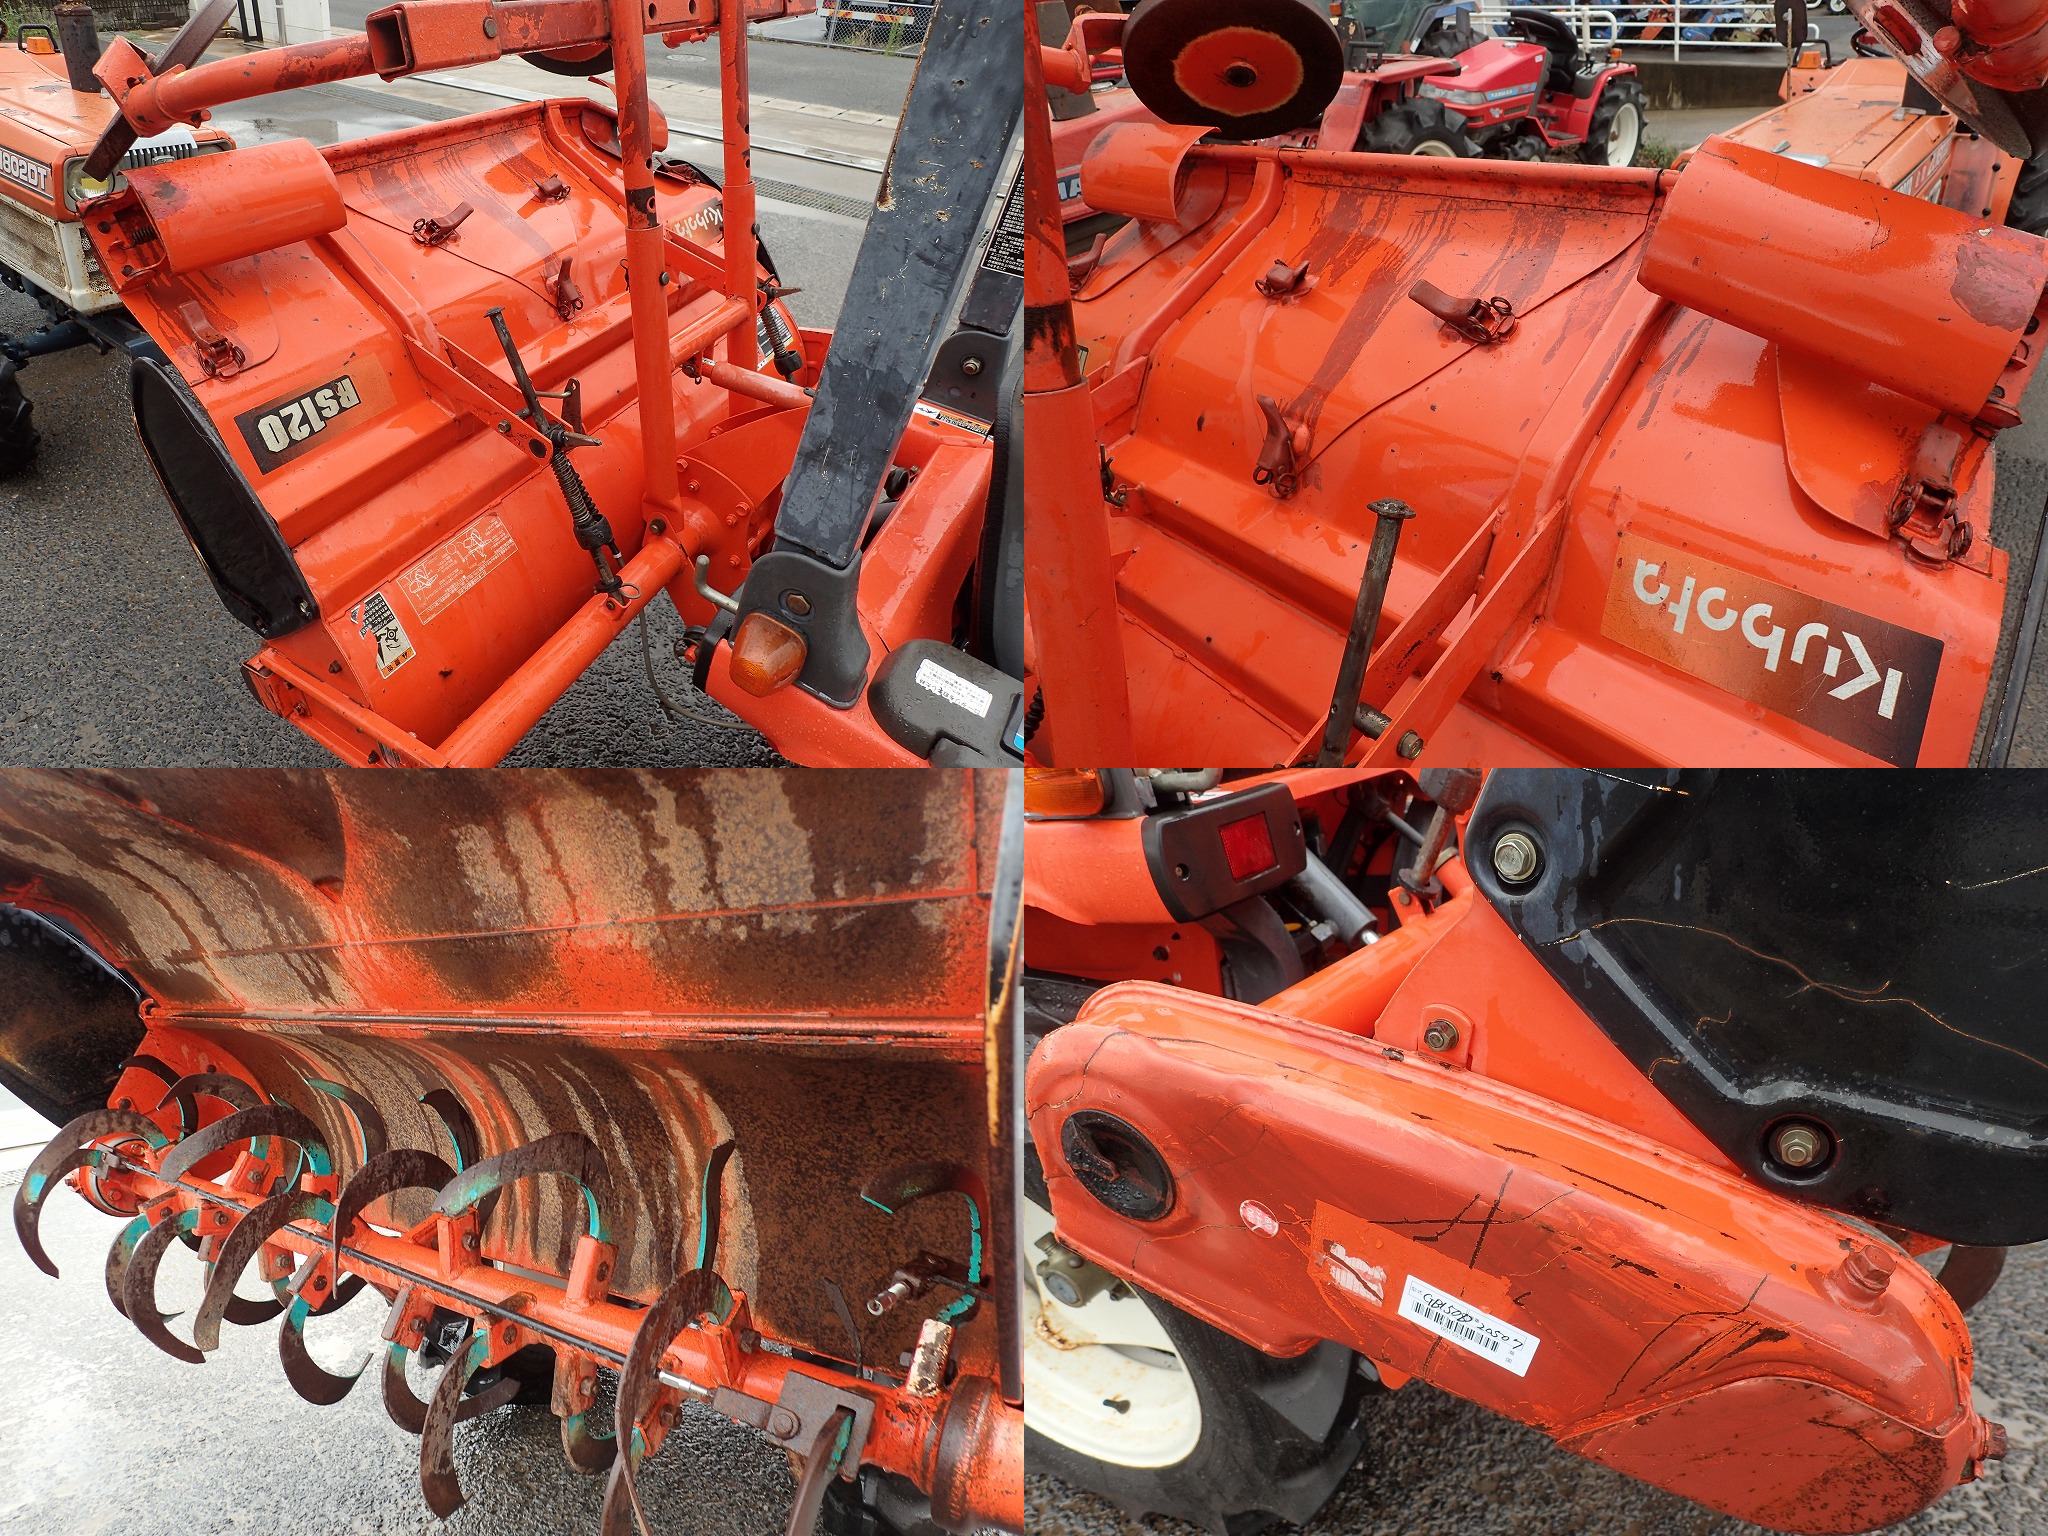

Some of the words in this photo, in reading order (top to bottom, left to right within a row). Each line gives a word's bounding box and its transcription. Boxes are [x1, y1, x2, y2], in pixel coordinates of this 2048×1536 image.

[257, 378, 360, 453] RS120
[1632, 558, 1903, 720] Kubota
[1476, 1322, 1524, 1350] 20507
